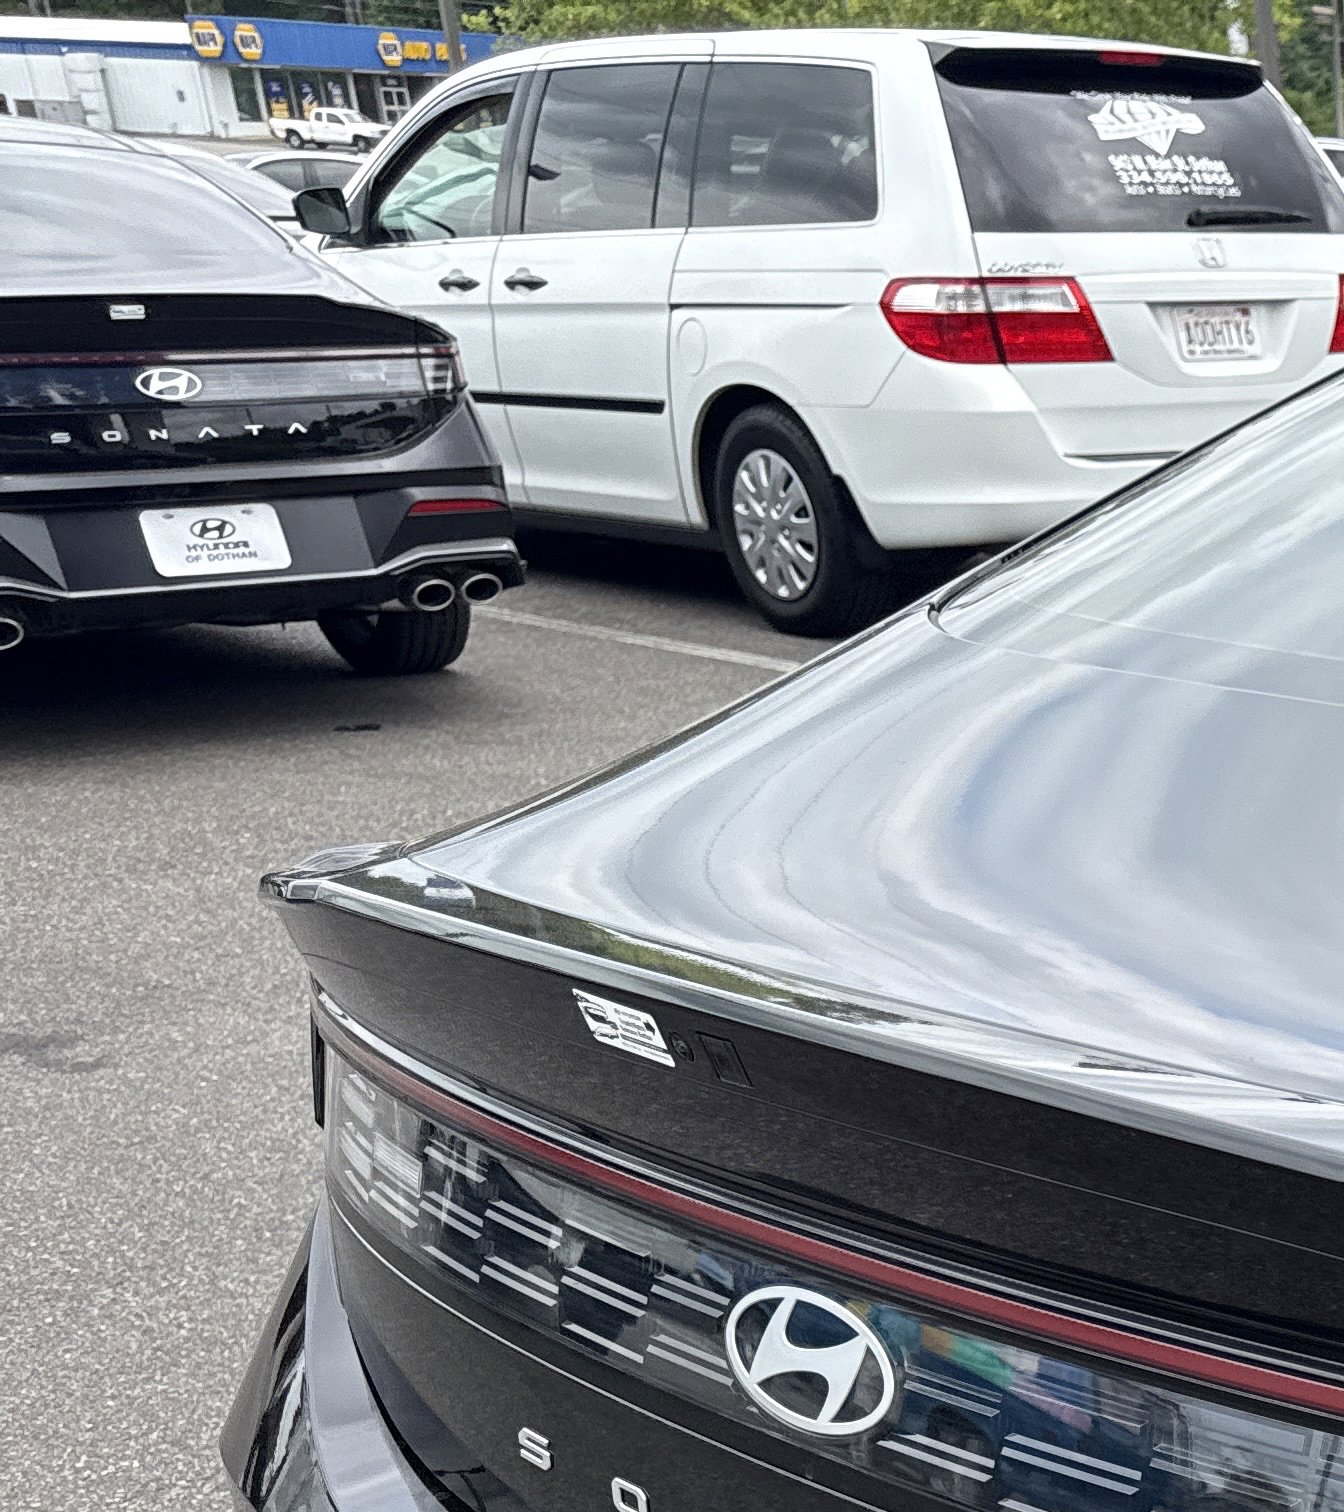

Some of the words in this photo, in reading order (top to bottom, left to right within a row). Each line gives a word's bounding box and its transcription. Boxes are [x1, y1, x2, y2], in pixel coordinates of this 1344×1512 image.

[50, 422, 308, 444] SONATA
[185, 540, 251, 553] HYUNDAI
[185, 554, 202, 564] OF
[207, 550, 259, 563] DOTHAN
